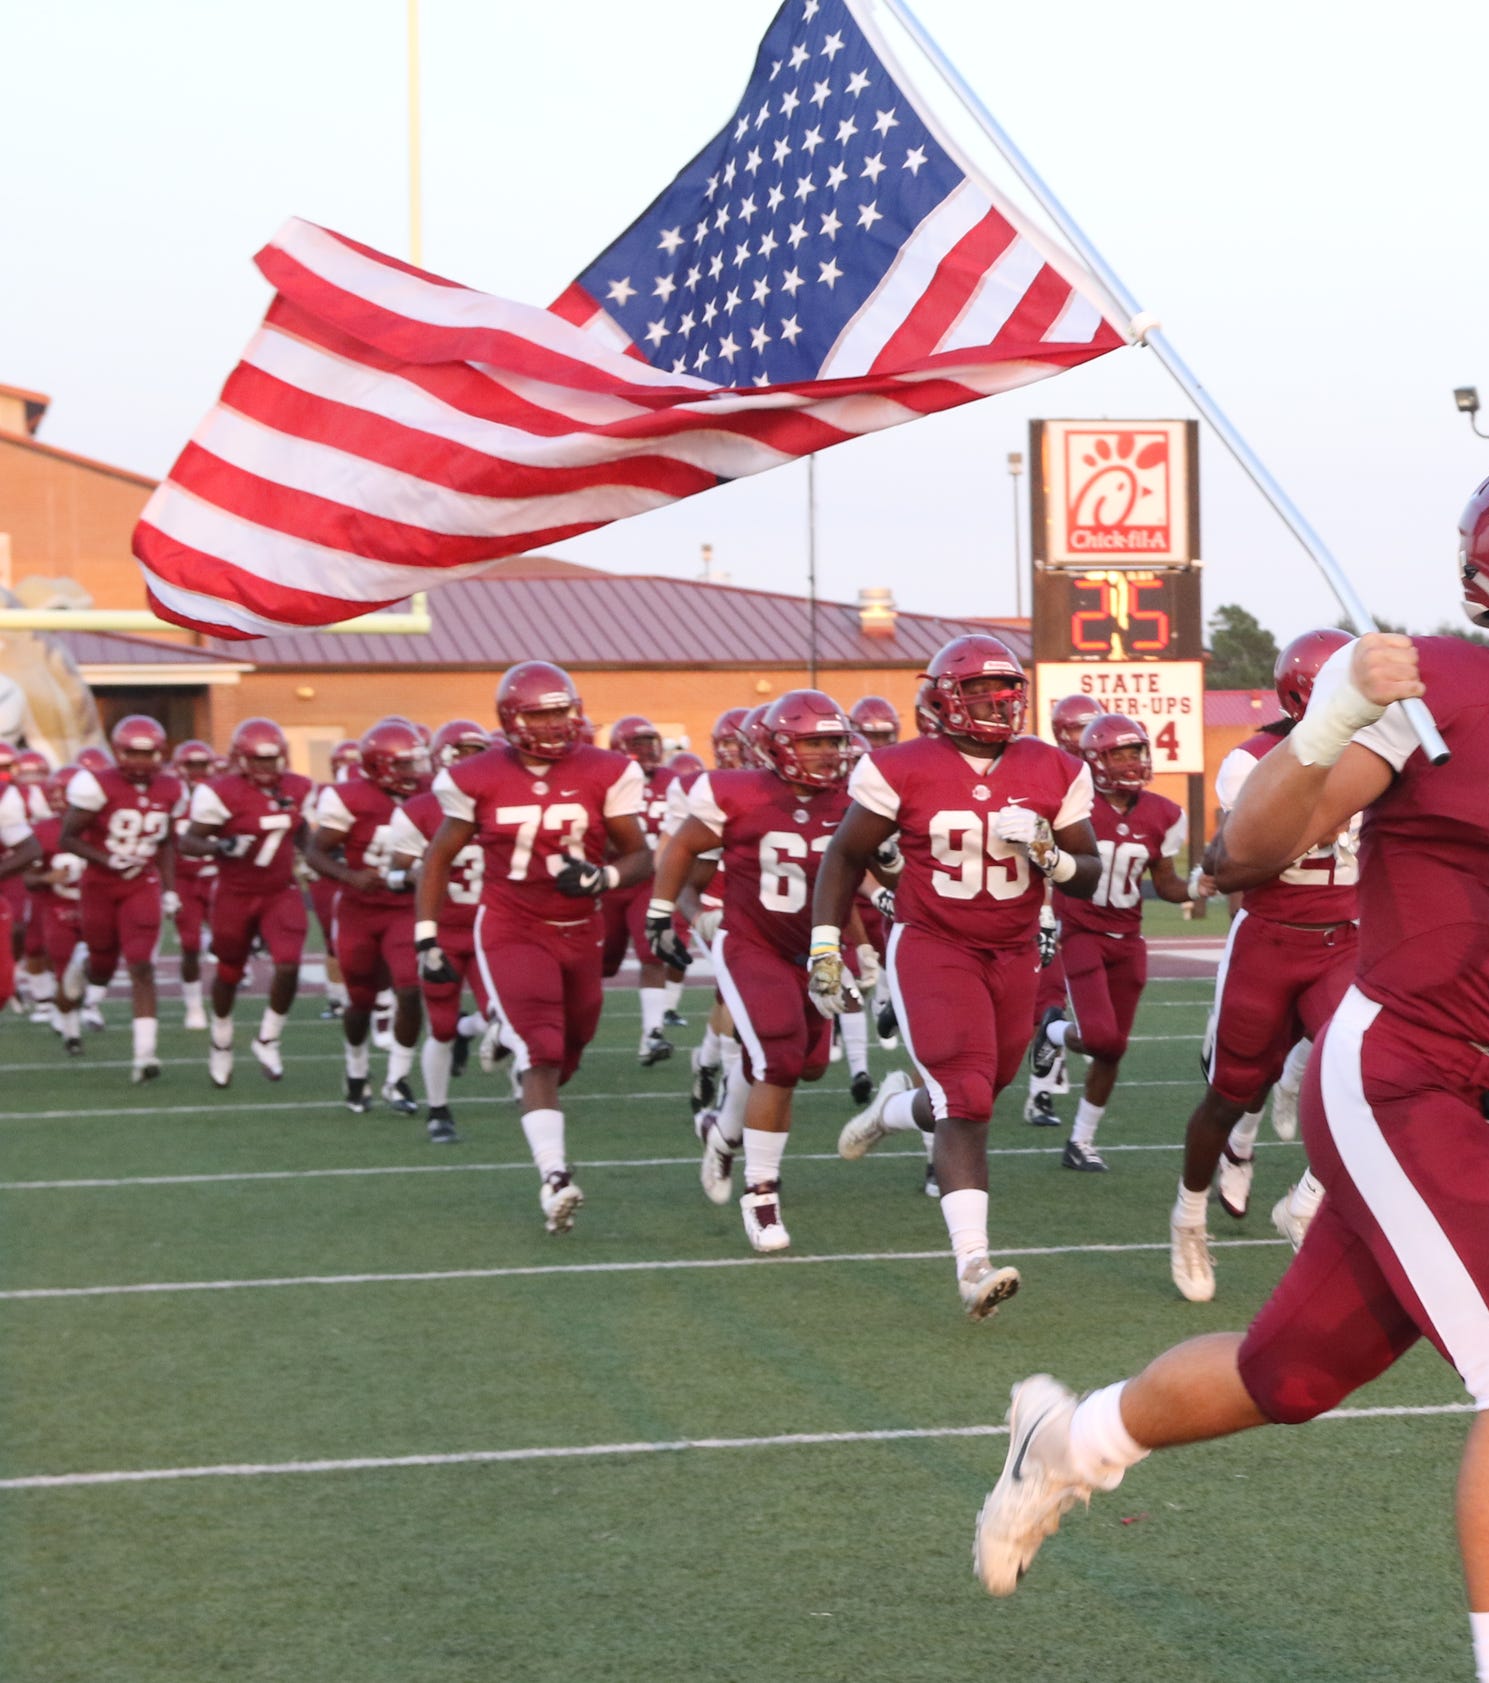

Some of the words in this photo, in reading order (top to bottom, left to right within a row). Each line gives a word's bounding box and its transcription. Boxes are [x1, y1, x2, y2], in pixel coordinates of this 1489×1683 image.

[1070, 530, 1167, 549] Chick-fil-A
[1072, 578, 1168, 651] 25
[1050, 697, 1191, 715] NER-UPS
[1081, 674, 1160, 694] STATE
[254, 814, 292, 868] 7
[496, 803, 589, 881] 73
[759, 831, 836, 914] 6
[929, 810, 1030, 901] 95
[1091, 840, 1149, 910] 10
